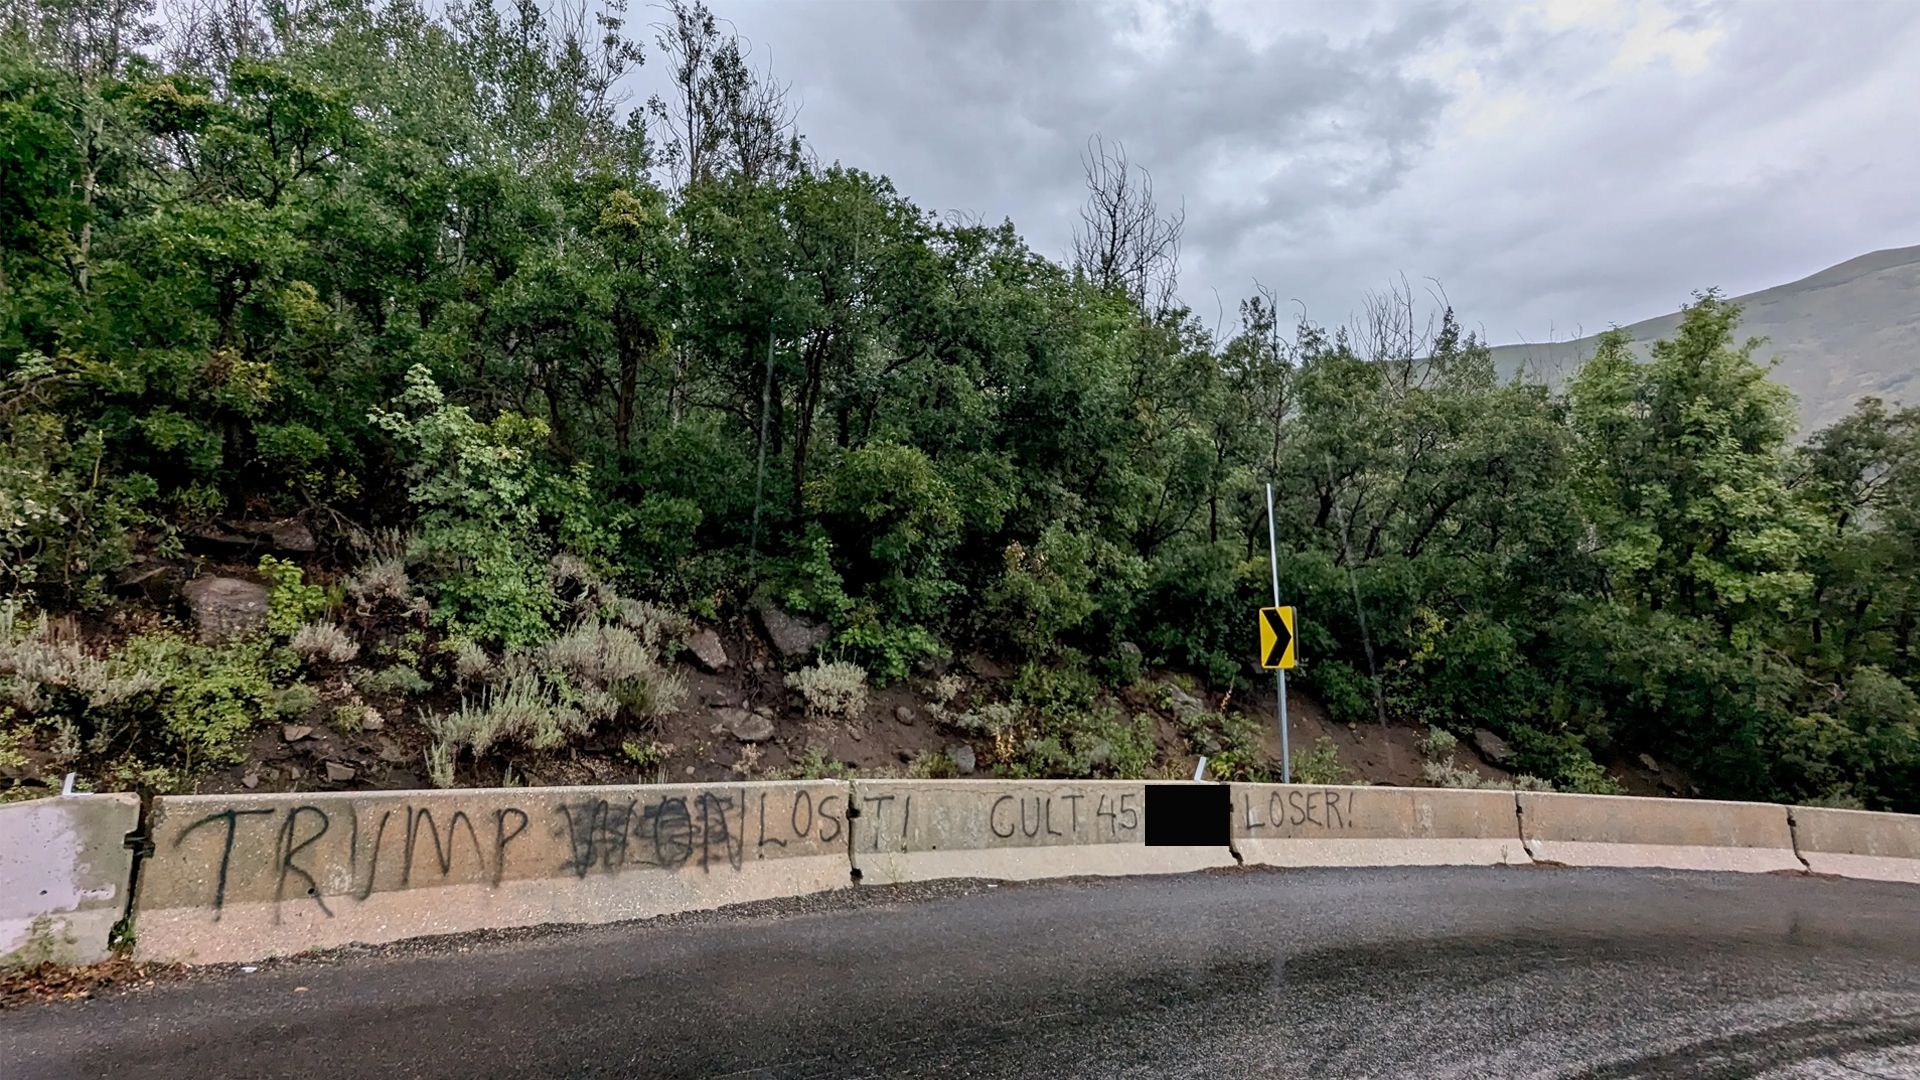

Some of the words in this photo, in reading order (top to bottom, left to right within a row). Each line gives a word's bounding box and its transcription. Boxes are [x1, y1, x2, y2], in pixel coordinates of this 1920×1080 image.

[173, 805, 529, 924] TRUMP
[990, 795, 1084, 838] CULT
[1096, 794, 1138, 836] 45
[1246, 788, 1353, 830] LOSER!
